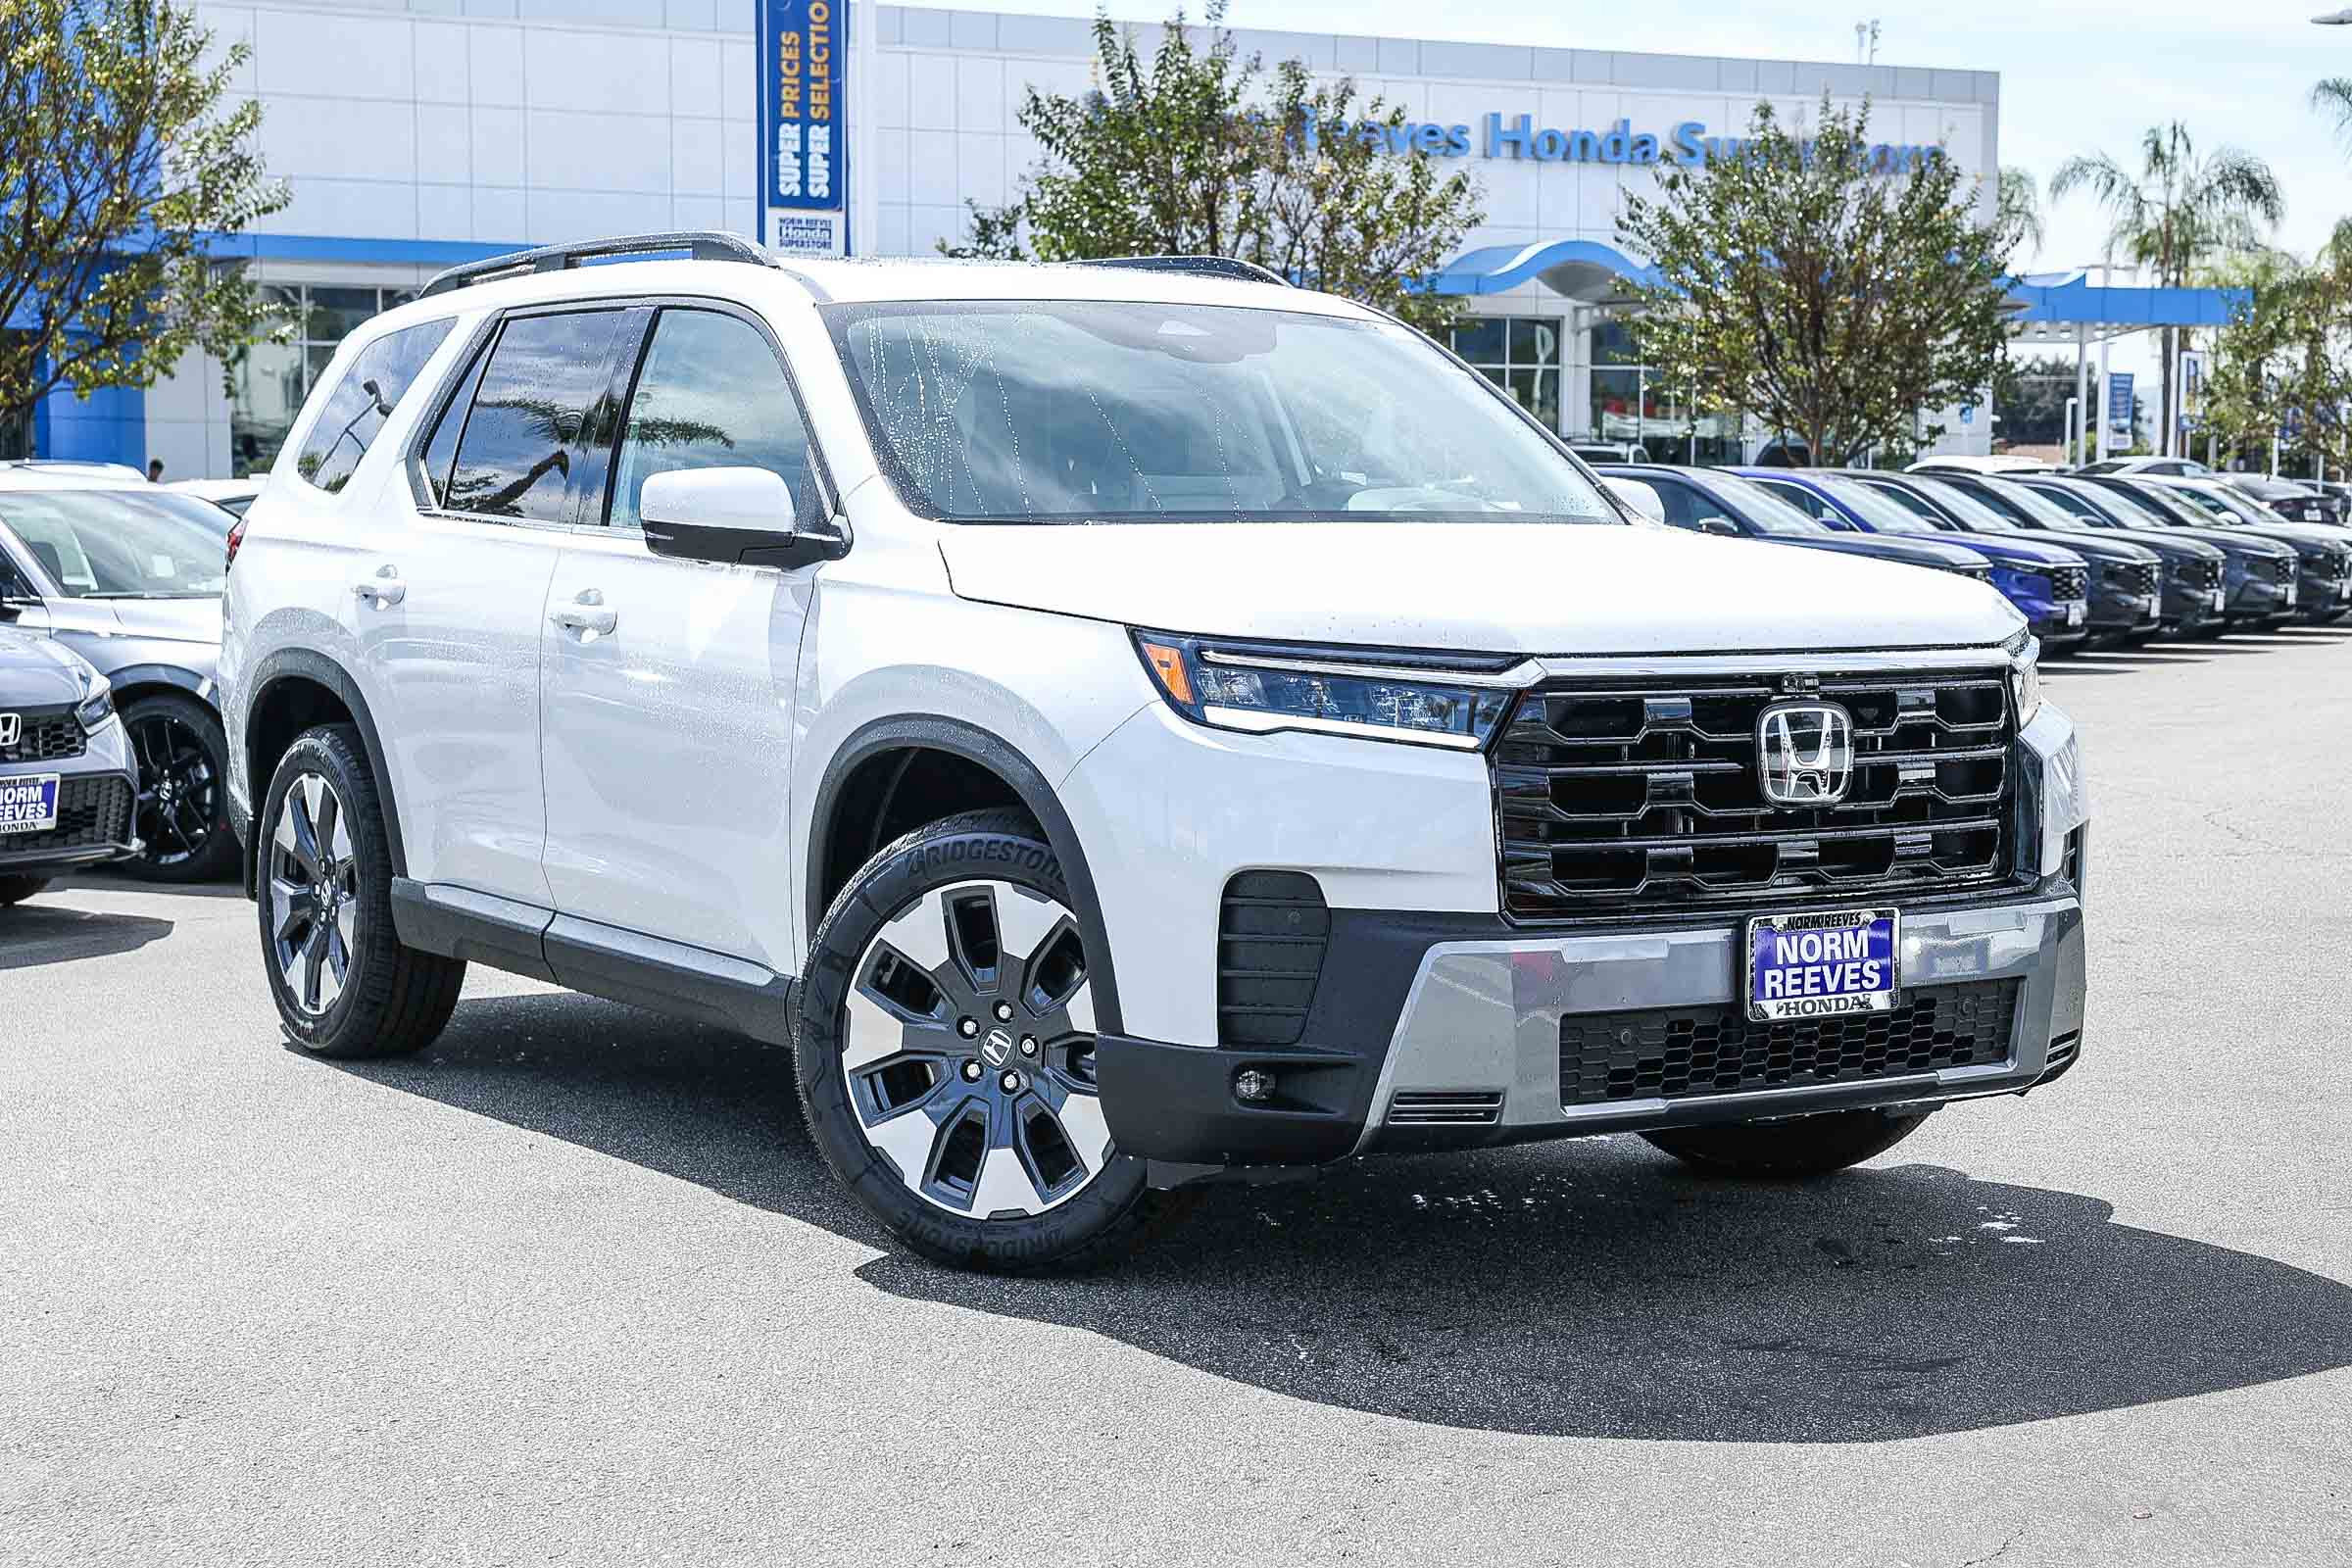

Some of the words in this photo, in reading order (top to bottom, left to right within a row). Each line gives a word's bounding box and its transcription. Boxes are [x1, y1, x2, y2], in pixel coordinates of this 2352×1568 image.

[781, 31, 800, 117] PRICES
[1484, 112, 1658, 164] Honda
[779, 122, 801, 196] SUPER
[808, 123, 830, 198] SUPER
[0, 821, 37, 832] ONDA
[1787, 914, 1821, 931] NORM
[1824, 911, 1860, 927] REEVES
[1776, 930, 1869, 964] NORM
[1764, 959, 1881, 998] REEVES
[1784, 996, 1864, 1015] HONDA
